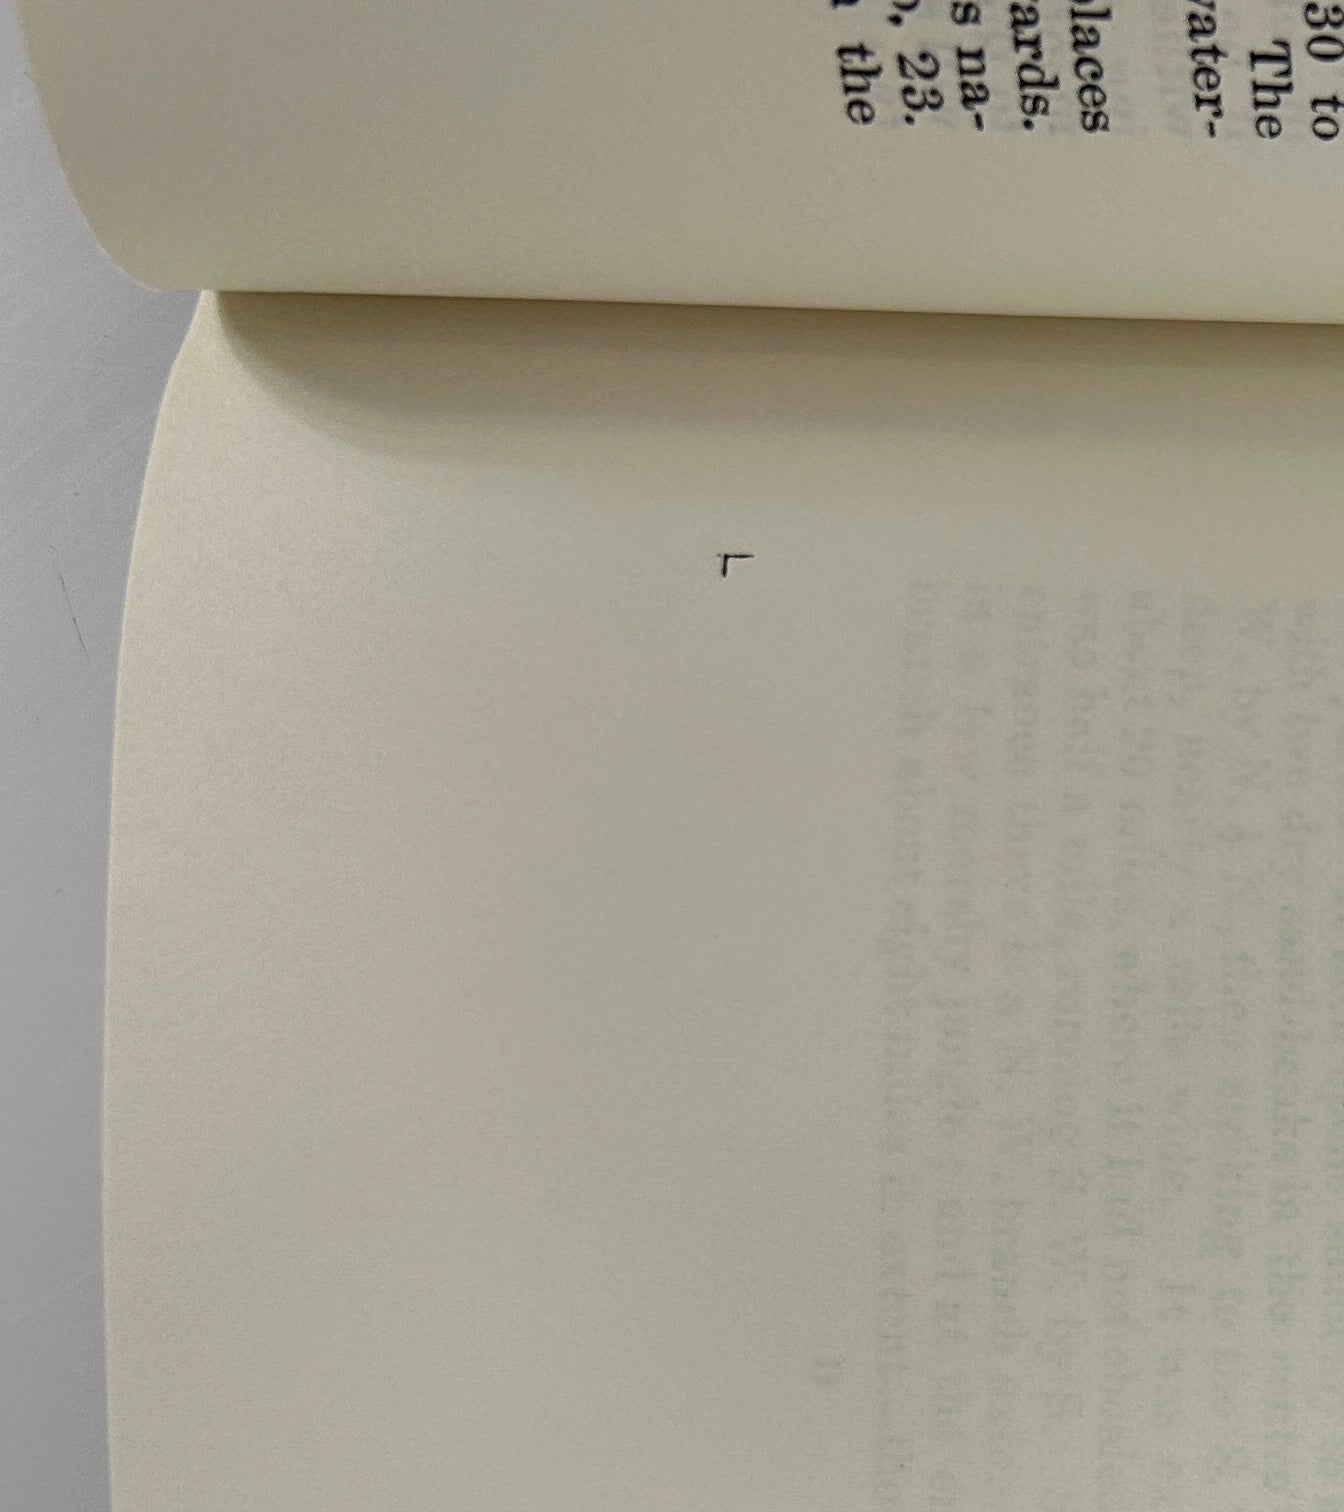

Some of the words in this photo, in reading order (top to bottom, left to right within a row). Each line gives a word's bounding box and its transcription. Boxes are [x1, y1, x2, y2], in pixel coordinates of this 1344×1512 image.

[835, 42, 883, 125] the
[896, 50, 944, 125] 23.
[955, 46, 990, 131] na-
[1008, 0, 1060, 130] ards.
[1067, 0, 1112, 133] laces
[1186, 0, 1228, 138] ater-
[1248, 38, 1294, 139] The
